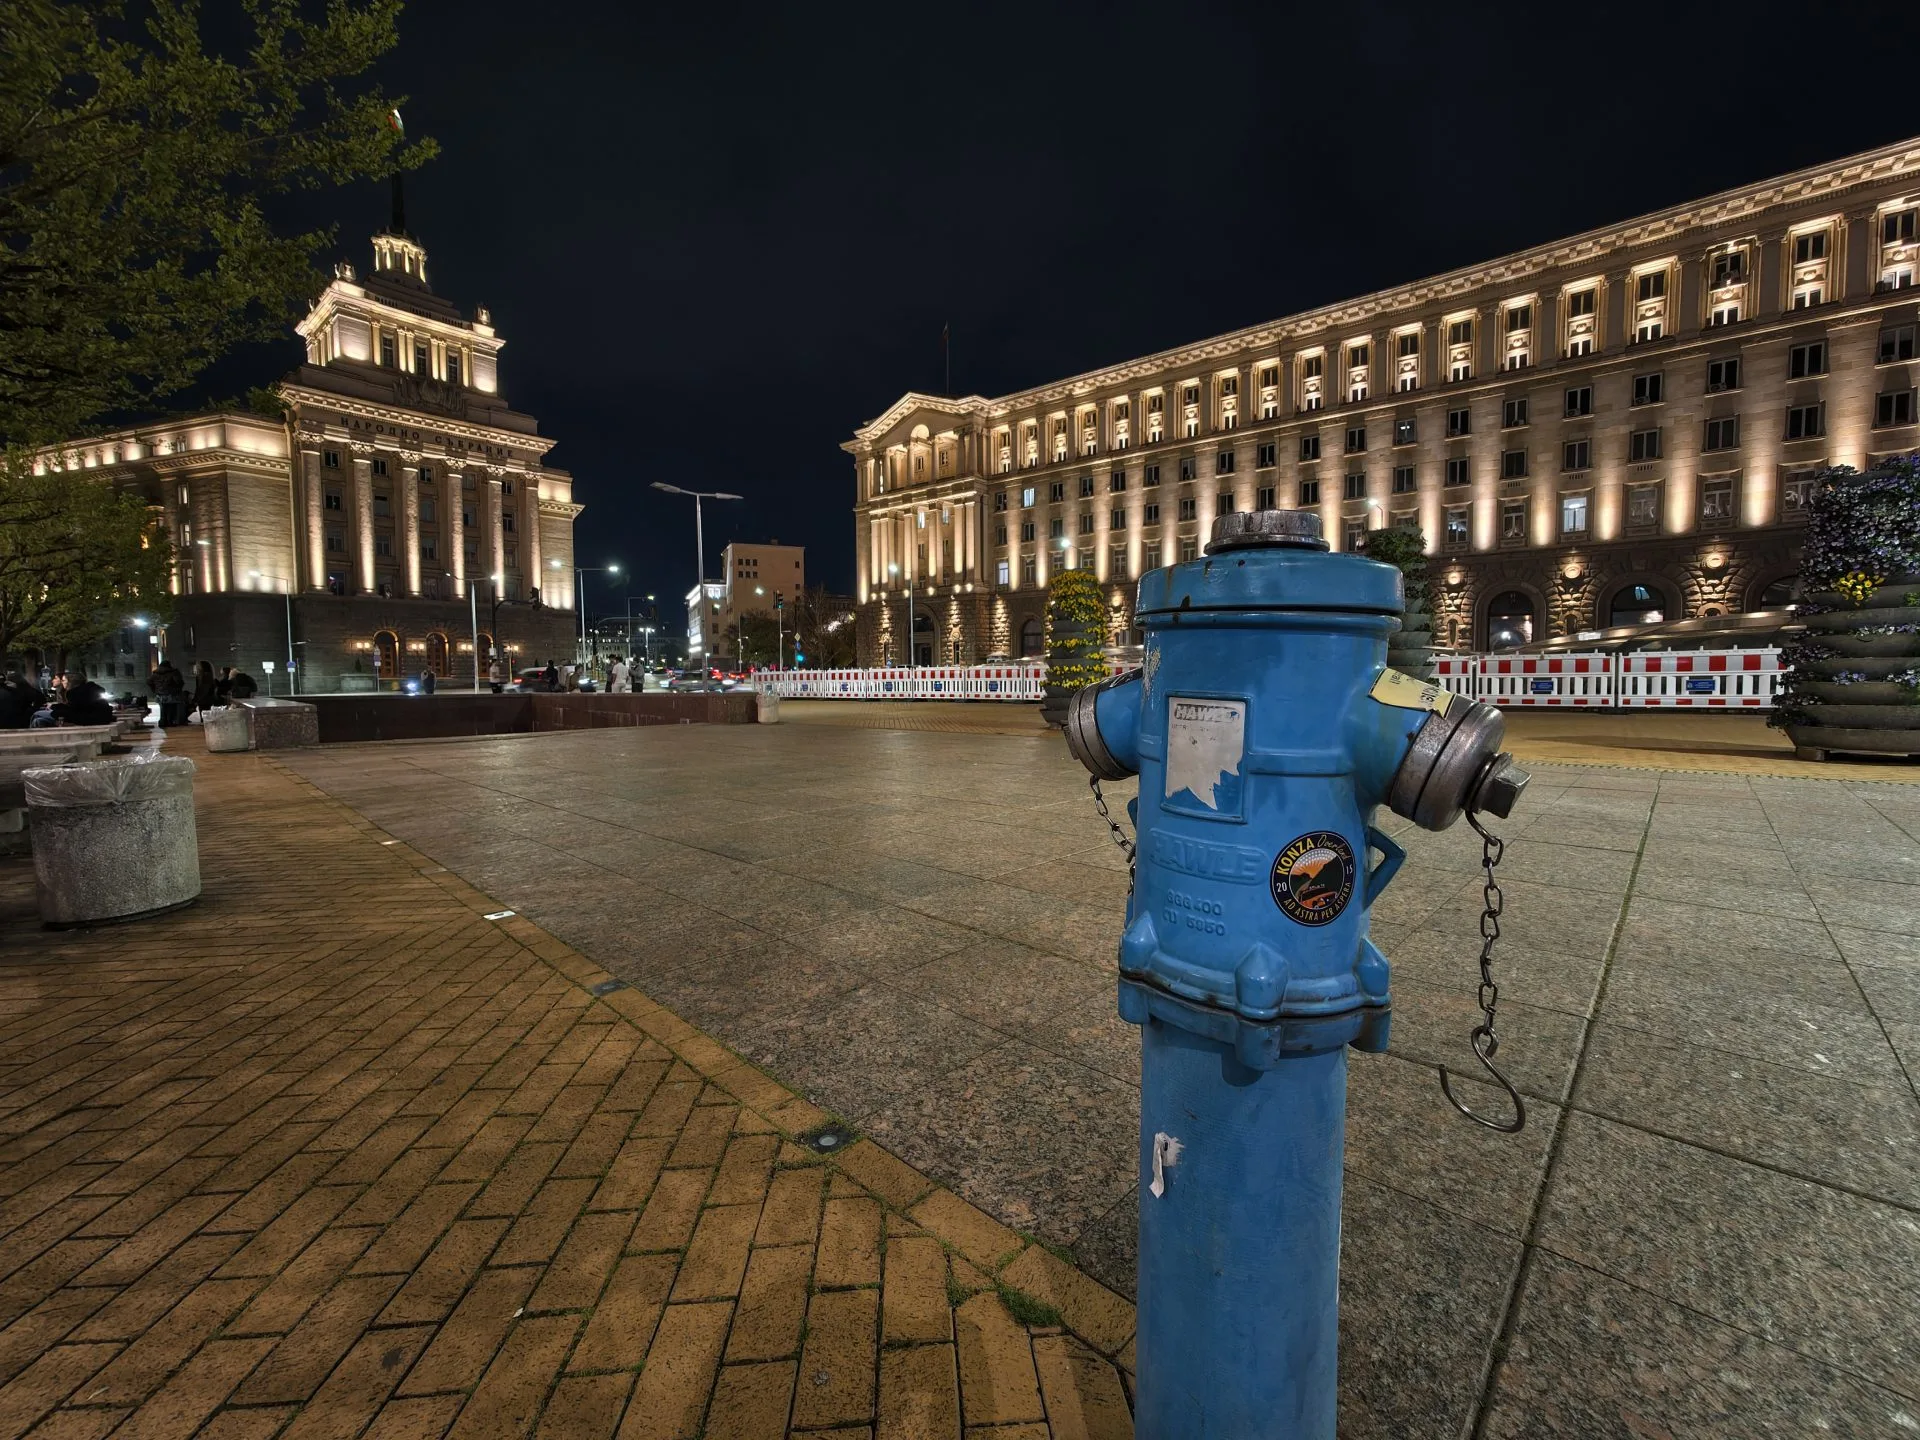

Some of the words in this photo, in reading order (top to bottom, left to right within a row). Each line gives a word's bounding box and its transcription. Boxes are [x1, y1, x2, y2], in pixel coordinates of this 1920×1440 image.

[340, 416, 420, 440] НАРОДНО
[434, 435, 513, 458] СЪБРАНИЕ
[1276, 837, 1315, 875] KONZA
[1346, 864, 1353, 875] 15
[1276, 881, 1288, 893] 20
[1283, 898, 1296, 910] AD
[1295, 908, 1319, 921] ASTRA
[1321, 907, 1335, 920] PER
[1335, 882, 1352, 911] ASPERA
